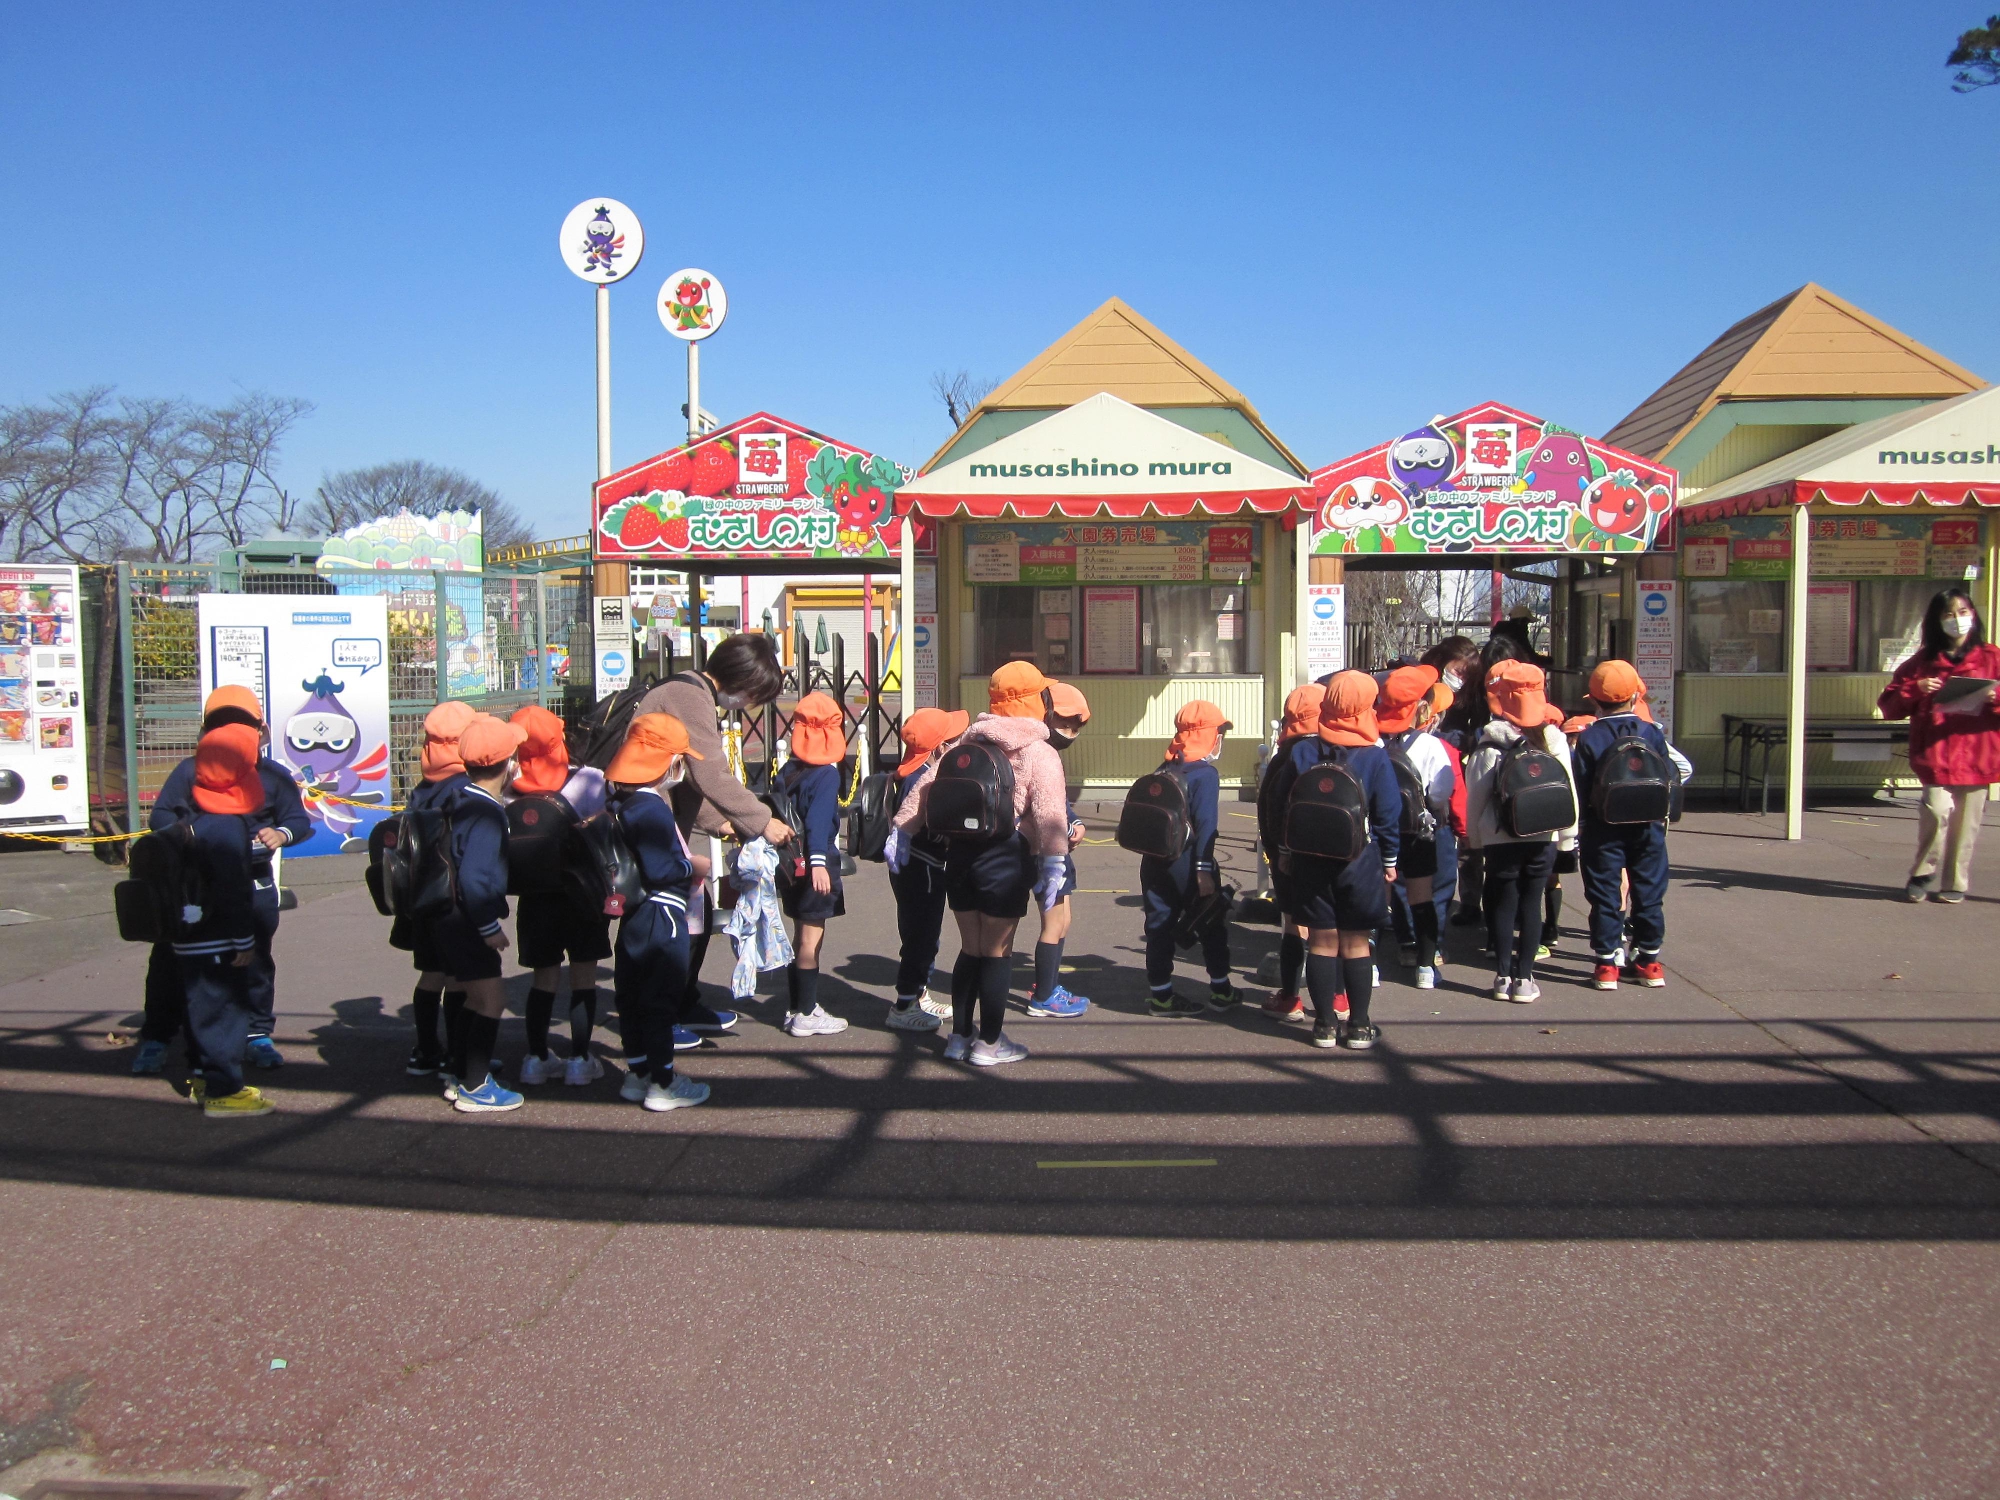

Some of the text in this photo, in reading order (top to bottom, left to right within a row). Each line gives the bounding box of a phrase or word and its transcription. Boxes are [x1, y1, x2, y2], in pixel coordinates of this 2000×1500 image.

[1471, 428, 1512, 468] 苺
[744, 438, 783, 477] 苺
[1878, 445, 2000, 465] musash
[969, 457, 1232, 478] musashino mura
[1461, 475, 1520, 487] STRAWBERRY
[736, 483, 790, 495] STRAWBERRY
[1427, 490, 1557, 504] 緑の中のファミリーランド
[704, 498, 824, 511] 緑の中のファミリーランド
[690, 515, 837, 546] むさしの村
[1411, 507, 1569, 541] むさしの村
[1063, 525, 1158, 544] 入園券売場
[1031, 549, 1066, 559] 入園料金
[1028, 566, 1069, 575] フリーパス
[1172, 564, 1196, 572] 2,900円
[1743, 560, 1785, 570] フリーパス
[1172, 572, 1196, 580] 2,300円
